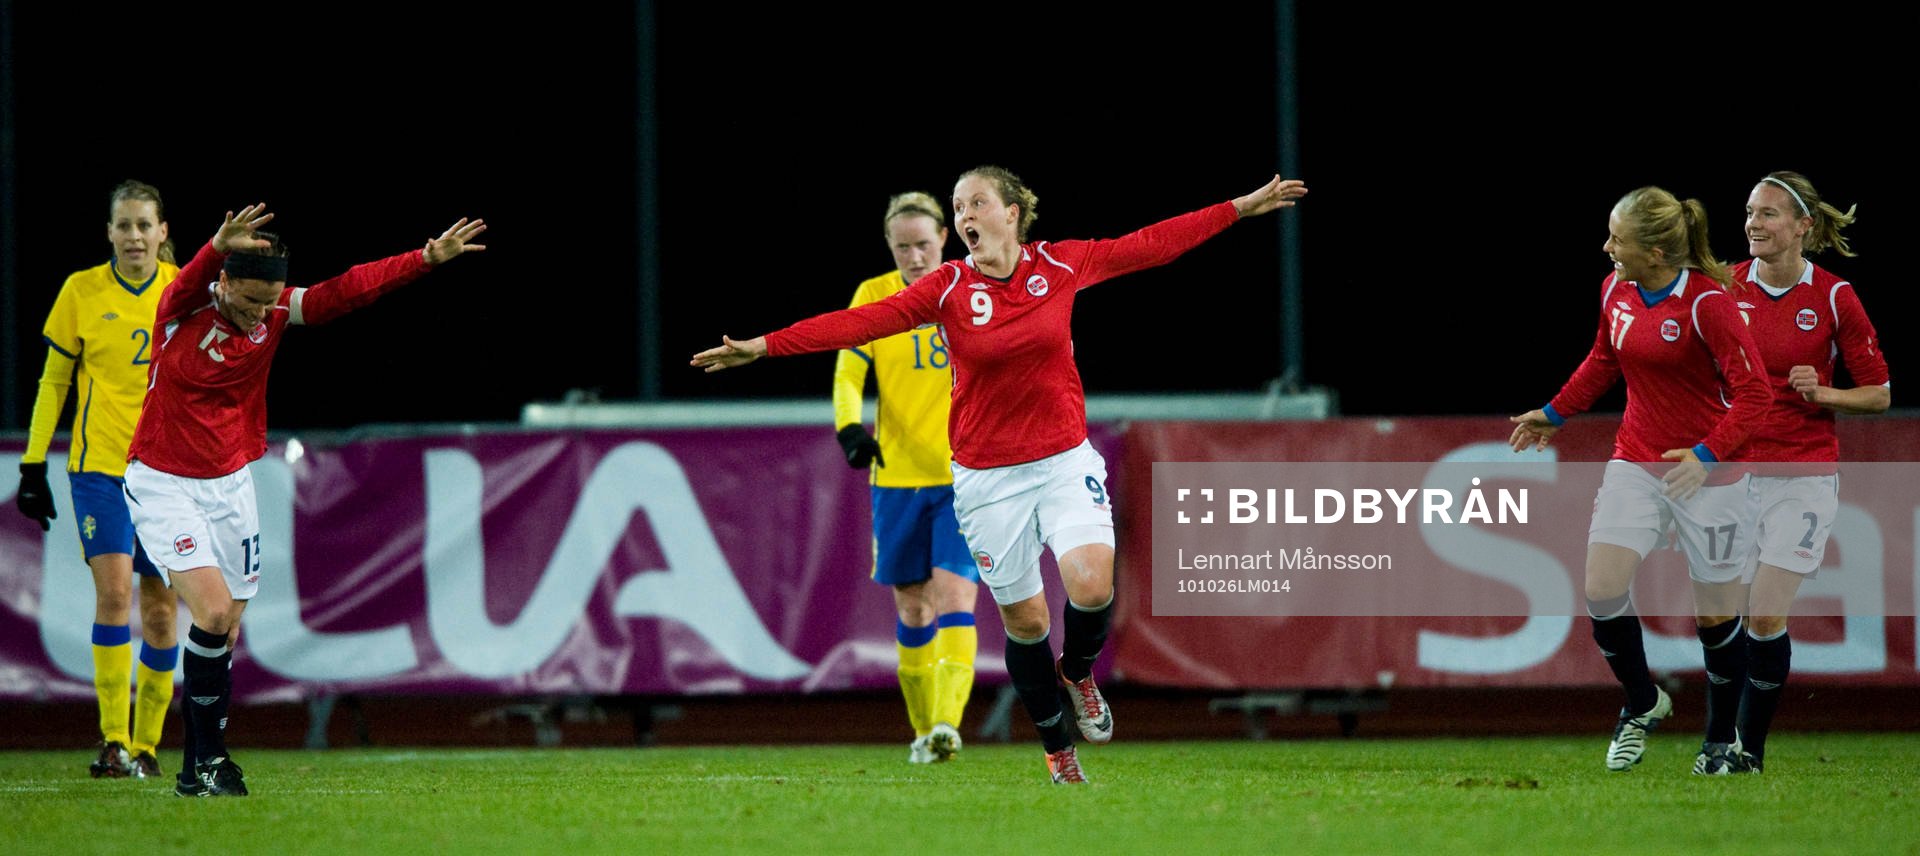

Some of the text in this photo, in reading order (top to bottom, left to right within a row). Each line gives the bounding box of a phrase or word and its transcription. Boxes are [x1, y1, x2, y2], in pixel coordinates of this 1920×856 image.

[970, 290, 993, 325] 9
[131, 328, 151, 365] 2
[1610, 307, 1635, 351] 17
[912, 333, 950, 369] 18
[1085, 475, 1105, 504] 9
[1704, 523, 1738, 561] 17
[1798, 511, 1818, 550] 2
[241, 533, 260, 576] 13
